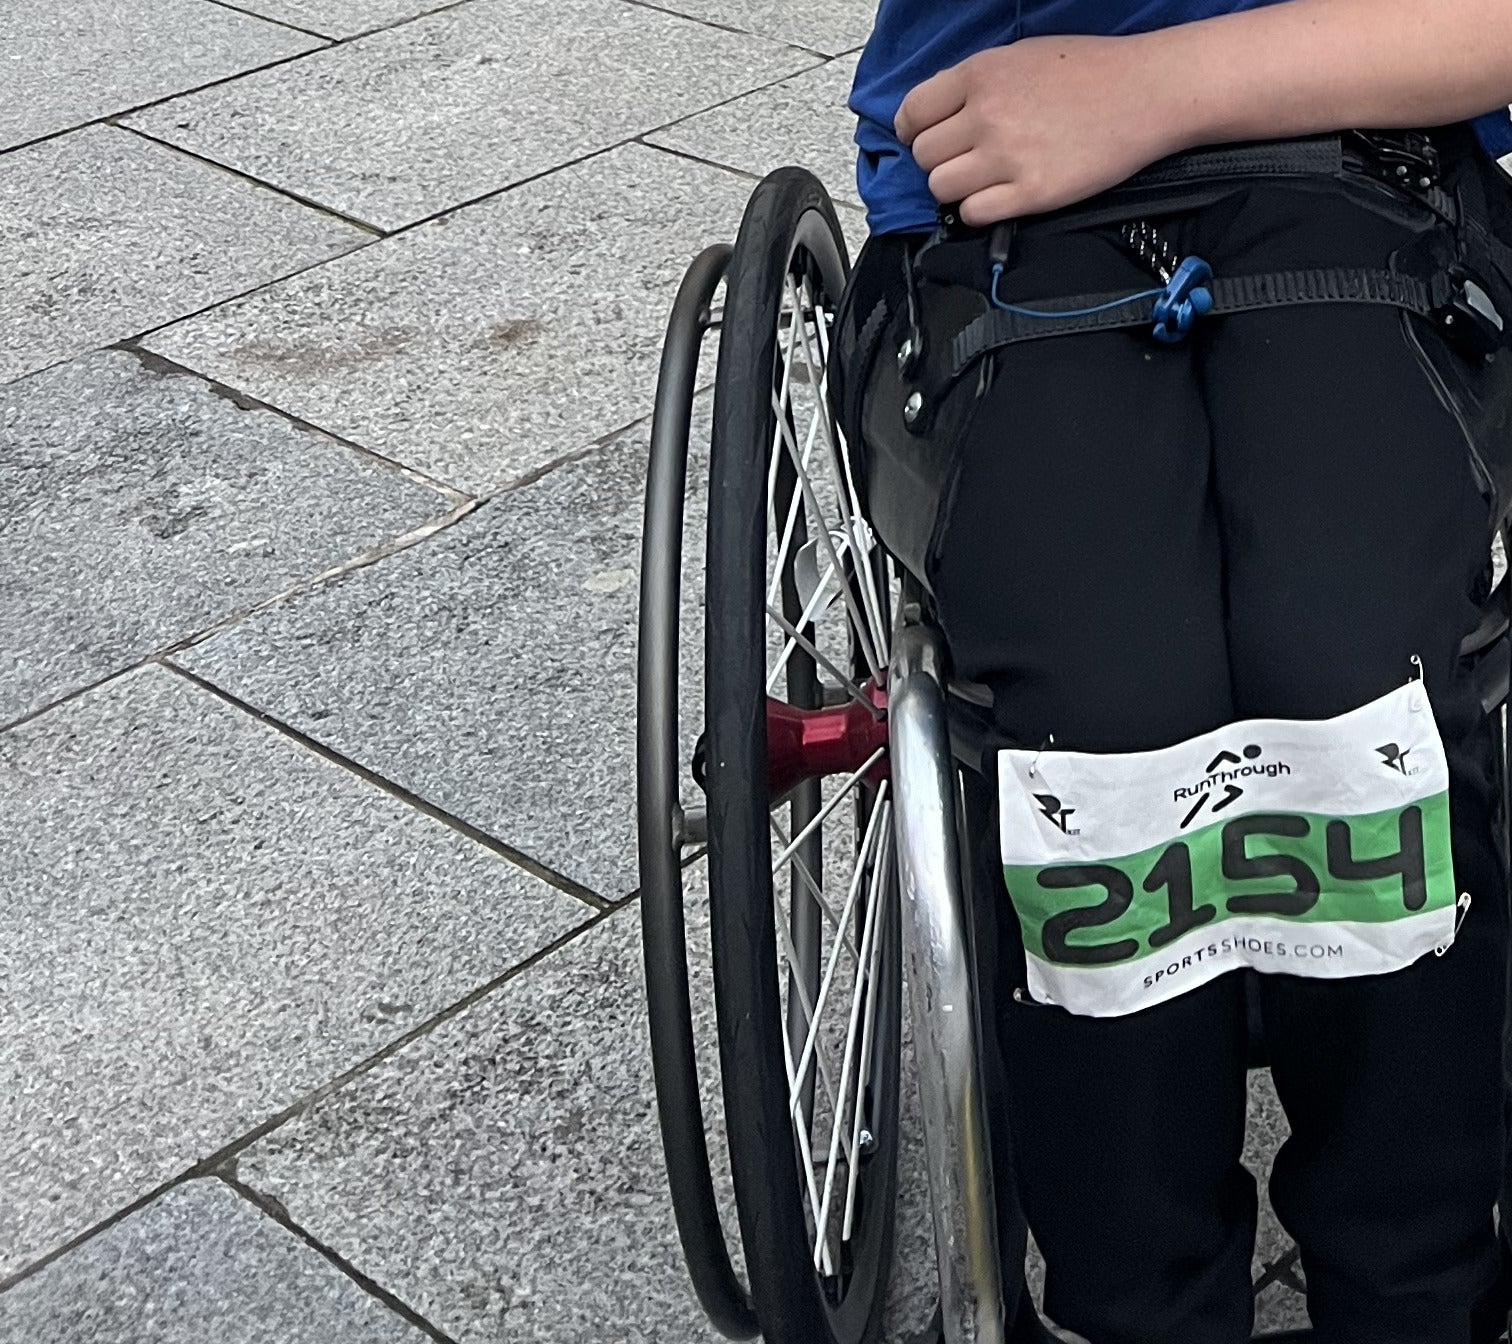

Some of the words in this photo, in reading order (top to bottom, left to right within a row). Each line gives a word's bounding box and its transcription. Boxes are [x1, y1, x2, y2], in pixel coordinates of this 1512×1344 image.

[1173, 760, 1292, 803] RunThrough
[1035, 804, 1428, 965] 2154
[1142, 936, 1344, 989] SPORTSSHOES.COM
